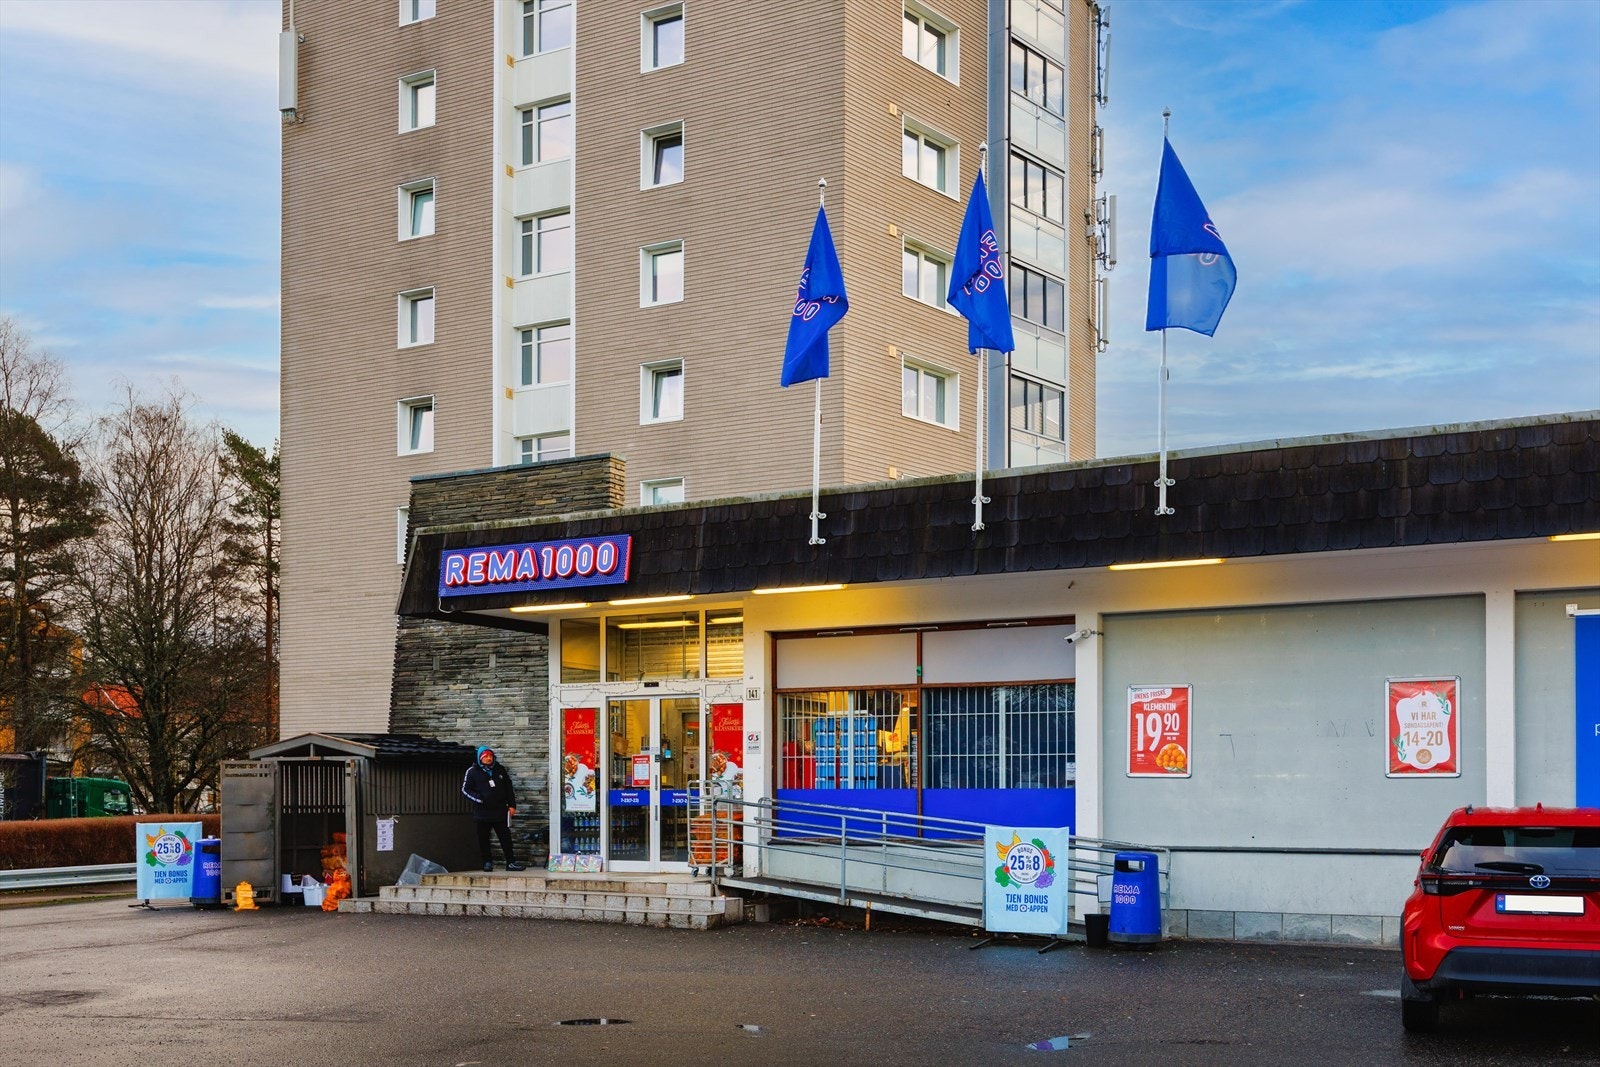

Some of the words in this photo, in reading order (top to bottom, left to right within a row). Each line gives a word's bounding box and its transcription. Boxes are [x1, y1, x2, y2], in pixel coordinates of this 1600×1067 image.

[445, 547, 539, 586] REMA
[541, 541, 618, 579] 1000
[748, 689, 758, 698] 141
[1144, 703, 1176, 711] KLEMENTIN
[1411, 712, 1418, 720] VI
[1421, 712, 1436, 720] HAR
[1136, 713, 1162, 751] 19
[1164, 712, 1180, 731] 90
[1403, 730, 1443, 746] 14-20
[157, 843, 169, 854] 25
[175, 843, 181, 853] 8
[1017, 846, 1034, 854] BONUS
[1010, 855, 1024, 870] 25
[1032, 855, 1040, 871] 8
[168, 870, 188, 878] BONUS
[1113, 884, 1141, 895] REMA
[1005, 893, 1022, 904] TJEN
[1024, 894, 1049, 904] BONUS
[1115, 894, 1137, 905] 1000
[1005, 903, 1019, 912] MED
